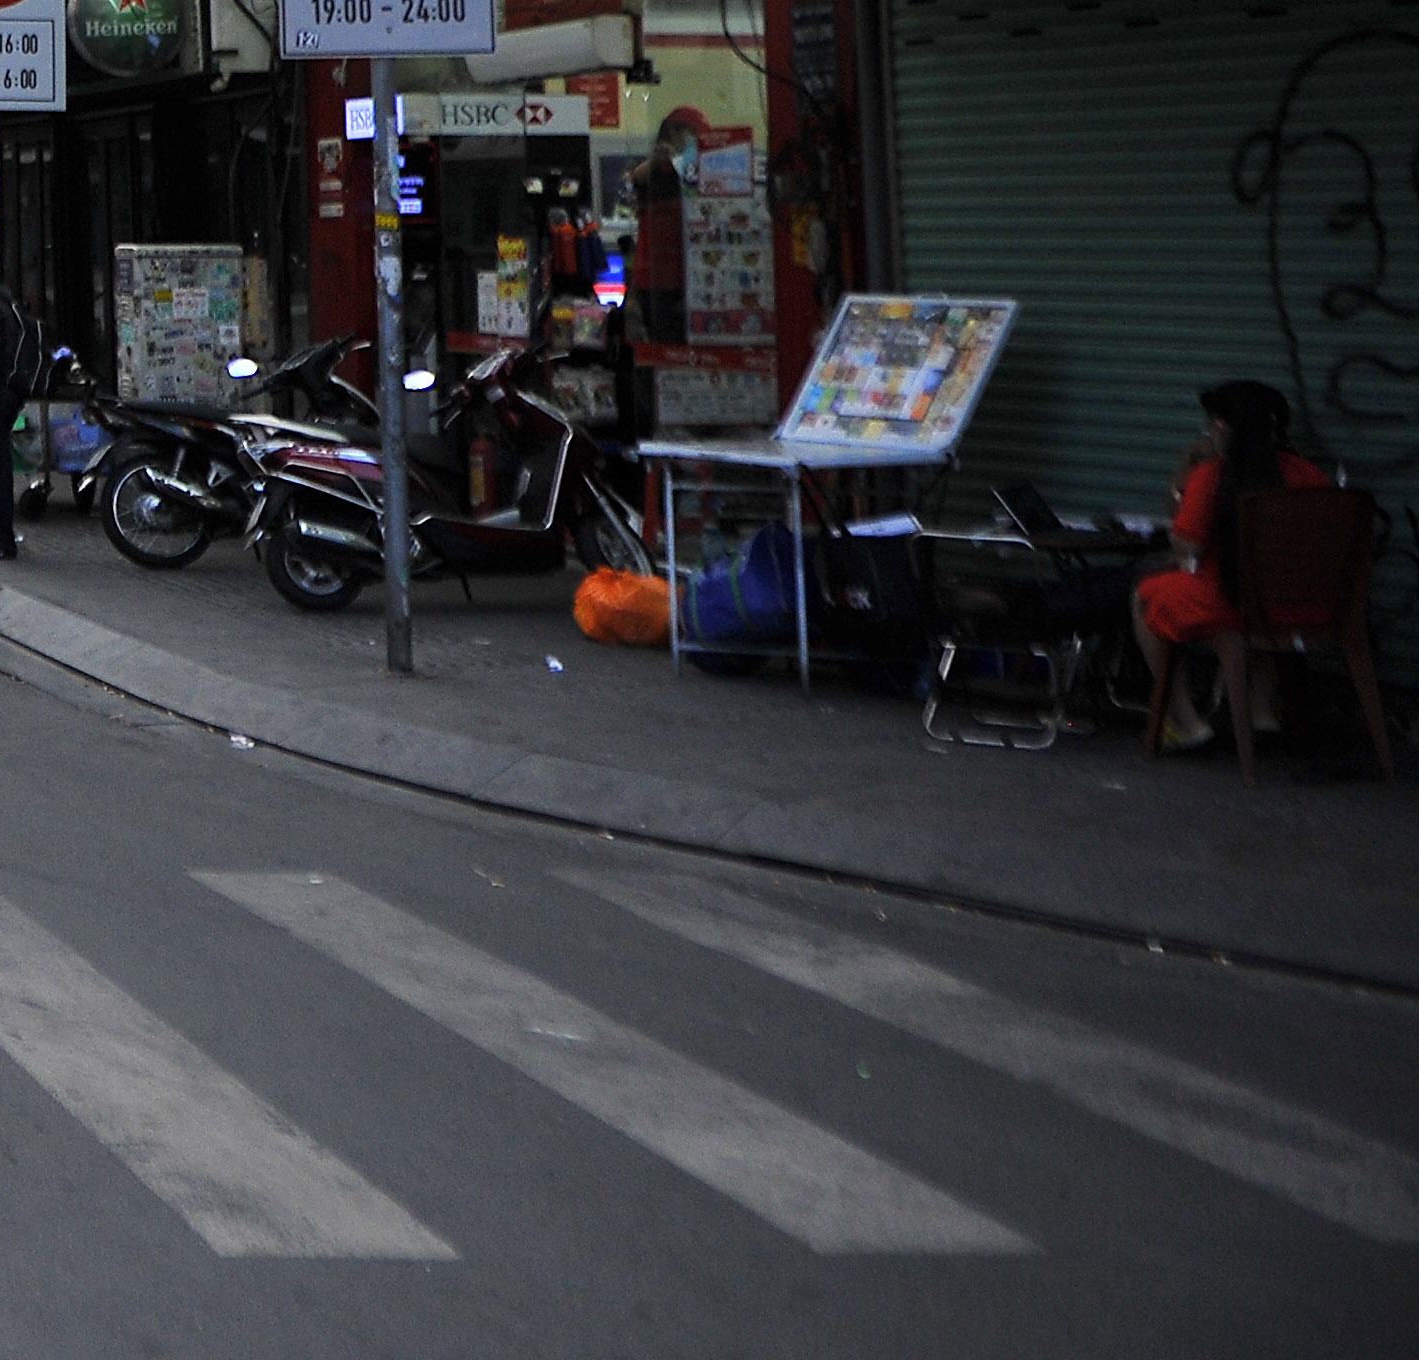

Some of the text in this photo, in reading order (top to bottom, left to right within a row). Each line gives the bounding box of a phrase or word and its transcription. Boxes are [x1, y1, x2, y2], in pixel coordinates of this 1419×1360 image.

[85, 17, 178, 38] Heineken
[3, 68, 38, 90] 6:00
[349, 108, 373, 131] HSB
[441, 104, 510, 126] HSBC
